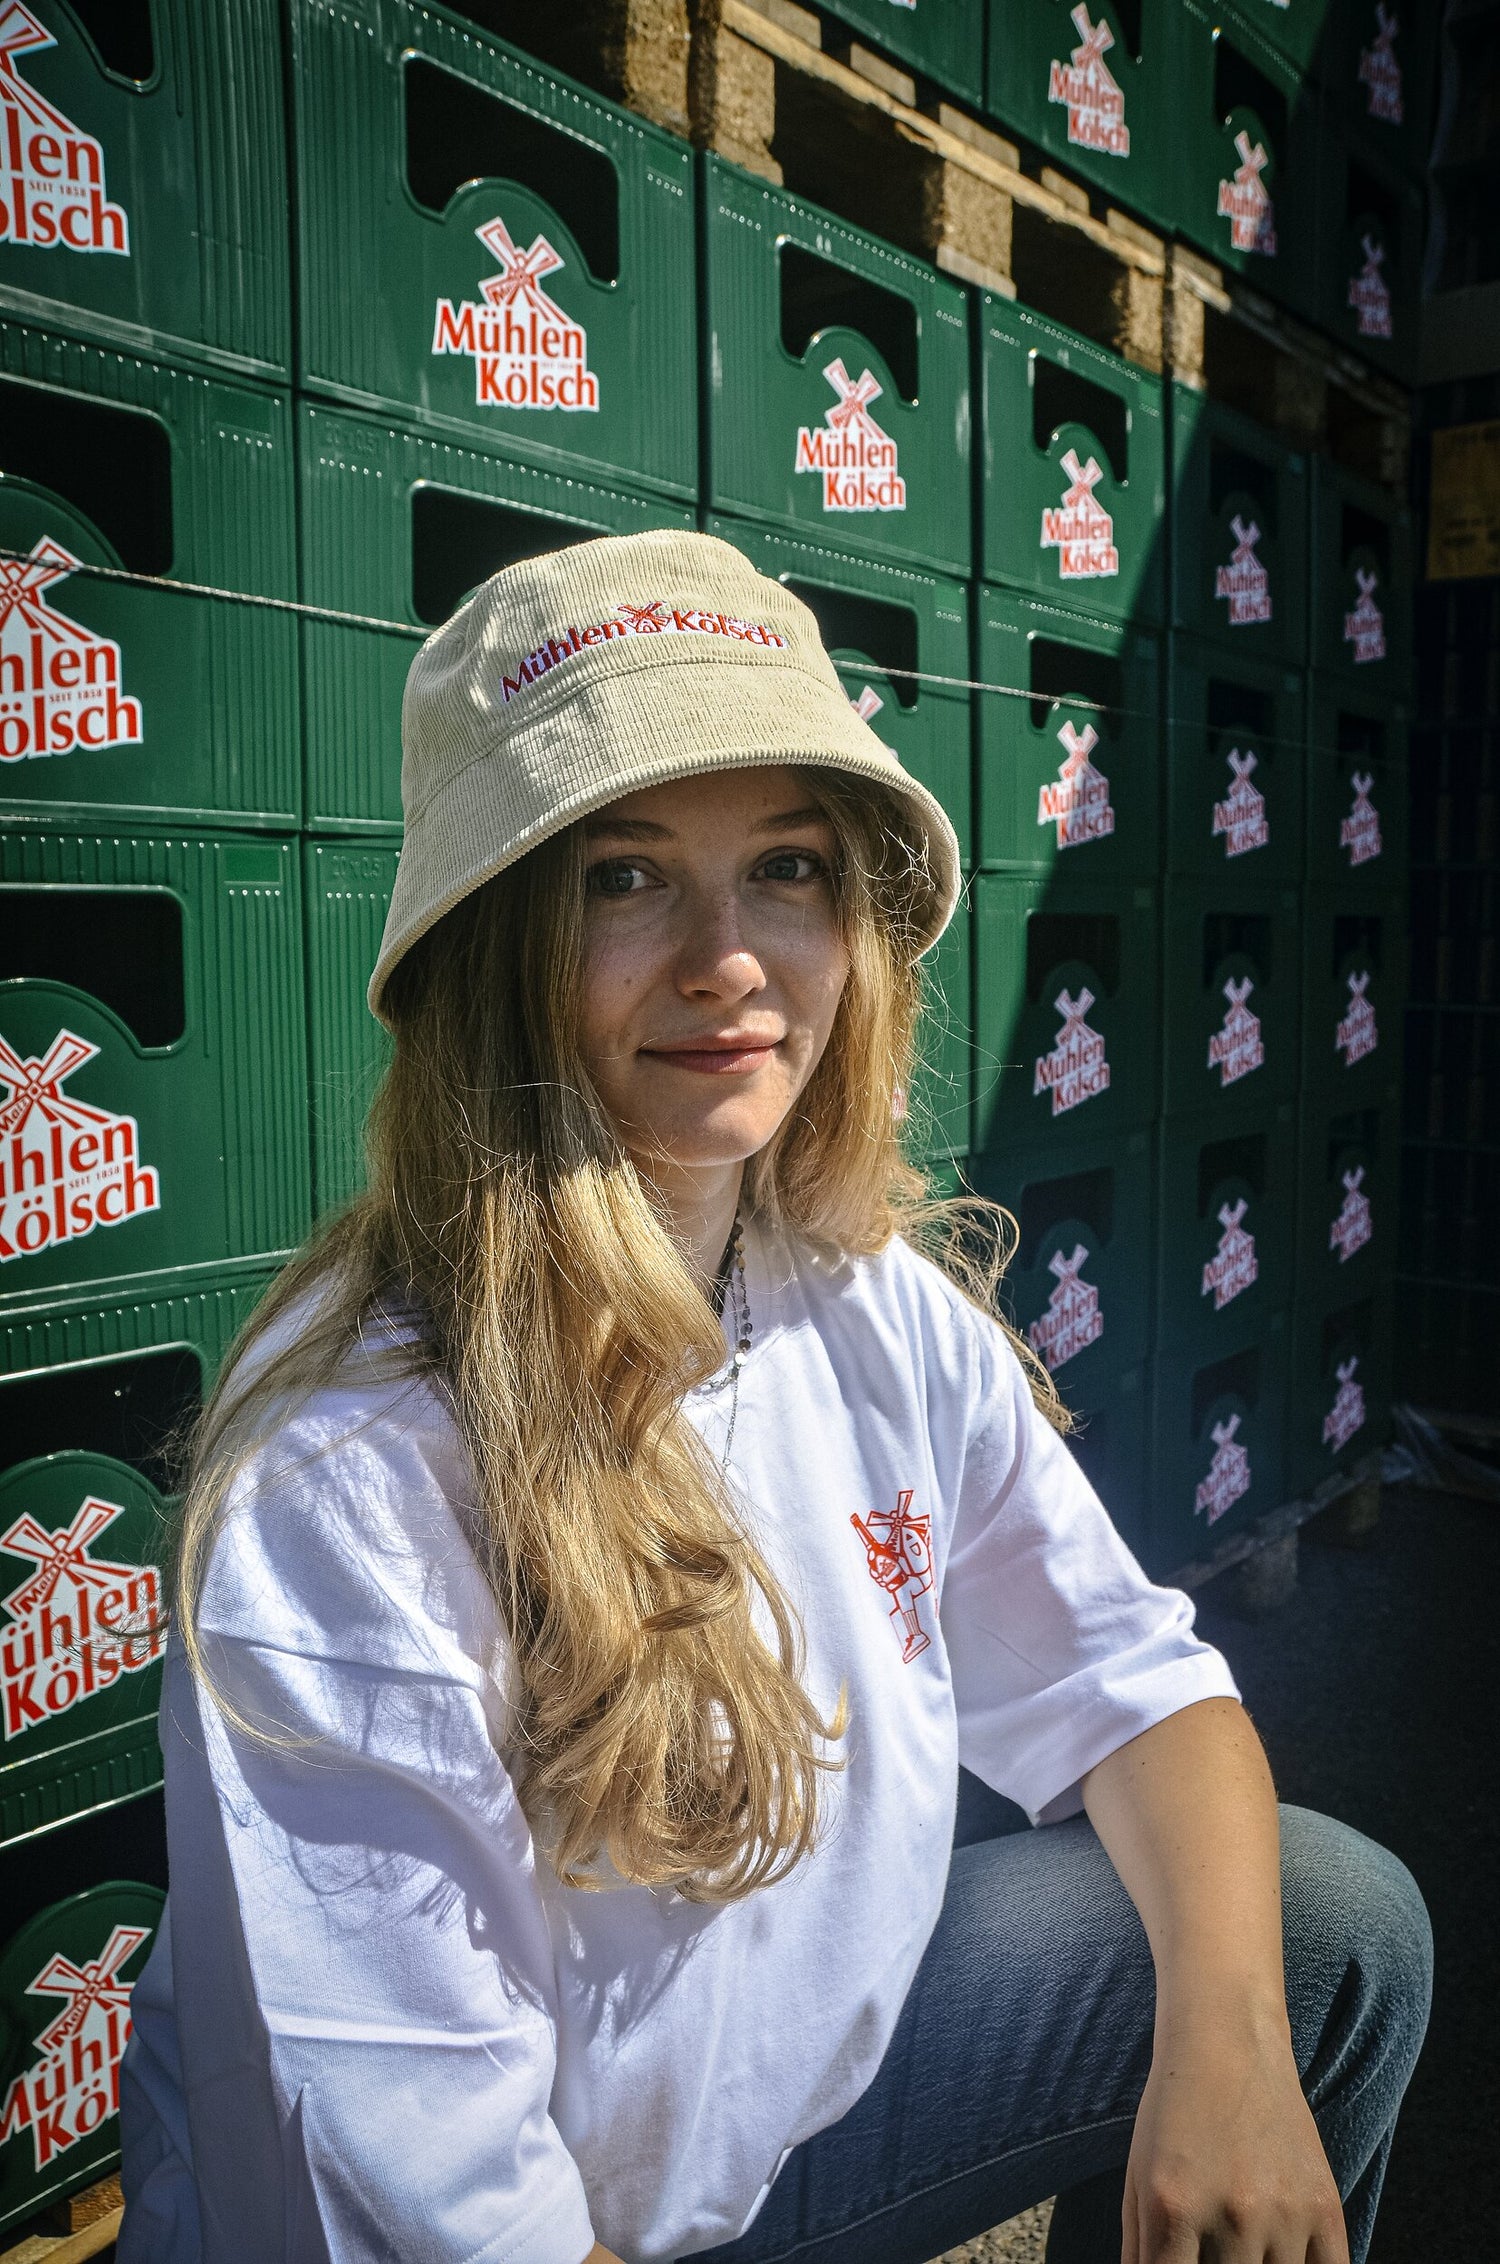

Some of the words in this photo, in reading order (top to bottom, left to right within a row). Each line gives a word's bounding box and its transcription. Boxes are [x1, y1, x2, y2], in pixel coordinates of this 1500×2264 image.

[0, 106, 100, 184] len
[29, 181, 53, 193] SEIT
[437, 305, 583, 359] Mühlen
[480, 357, 595, 406] Kölsch
[800, 431, 894, 468] Mühlen
[828, 471, 903, 506] Kölsch
[501, 621, 626, 702] Mühlen
[673, 610, 784, 648] Kölsch
[0, 687, 137, 757] ölsch
[51, 692, 72, 703] SEIT
[0, 1121, 133, 1198] hlen
[69, 1177, 90, 1189] SEIT
[0, 2010, 133, 2142] Mühl
